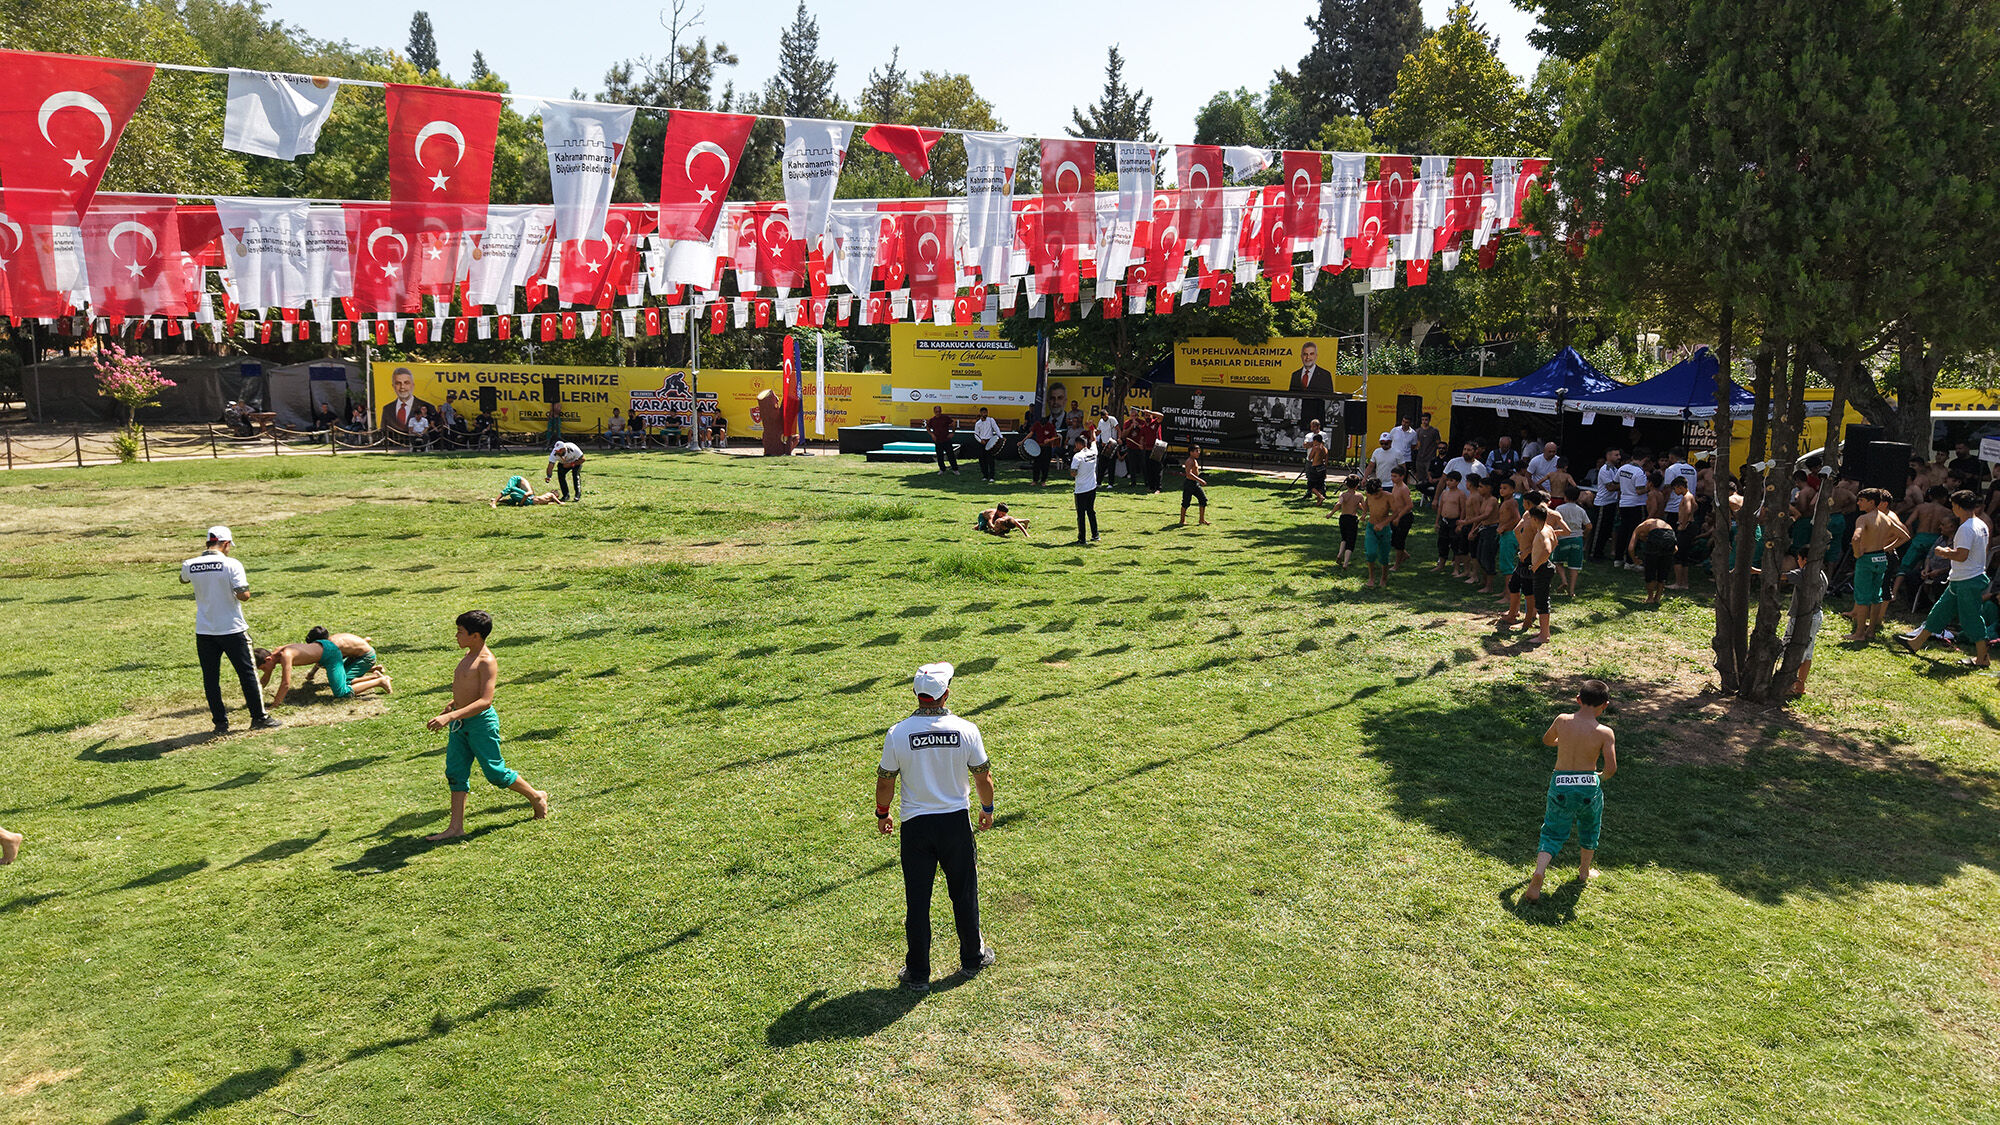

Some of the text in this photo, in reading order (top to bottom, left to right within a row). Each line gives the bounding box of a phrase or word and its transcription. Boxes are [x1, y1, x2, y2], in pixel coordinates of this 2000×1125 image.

[581, 163, 611, 175] Belediyes
[787, 160, 837, 170] Kahramanma
[306, 239, 347, 247] ahramanmaraş
[959, 350, 997, 362] Geldiniz
[1190, 358, 1242, 368] BAŞARILAR
[447, 389, 541, 403] BAŞRILAR
[546, 412, 581, 420] GRGEL
[912, 734, 958, 747] ÖZÜNLÜ
[1556, 776, 1579, 784] BERAT
